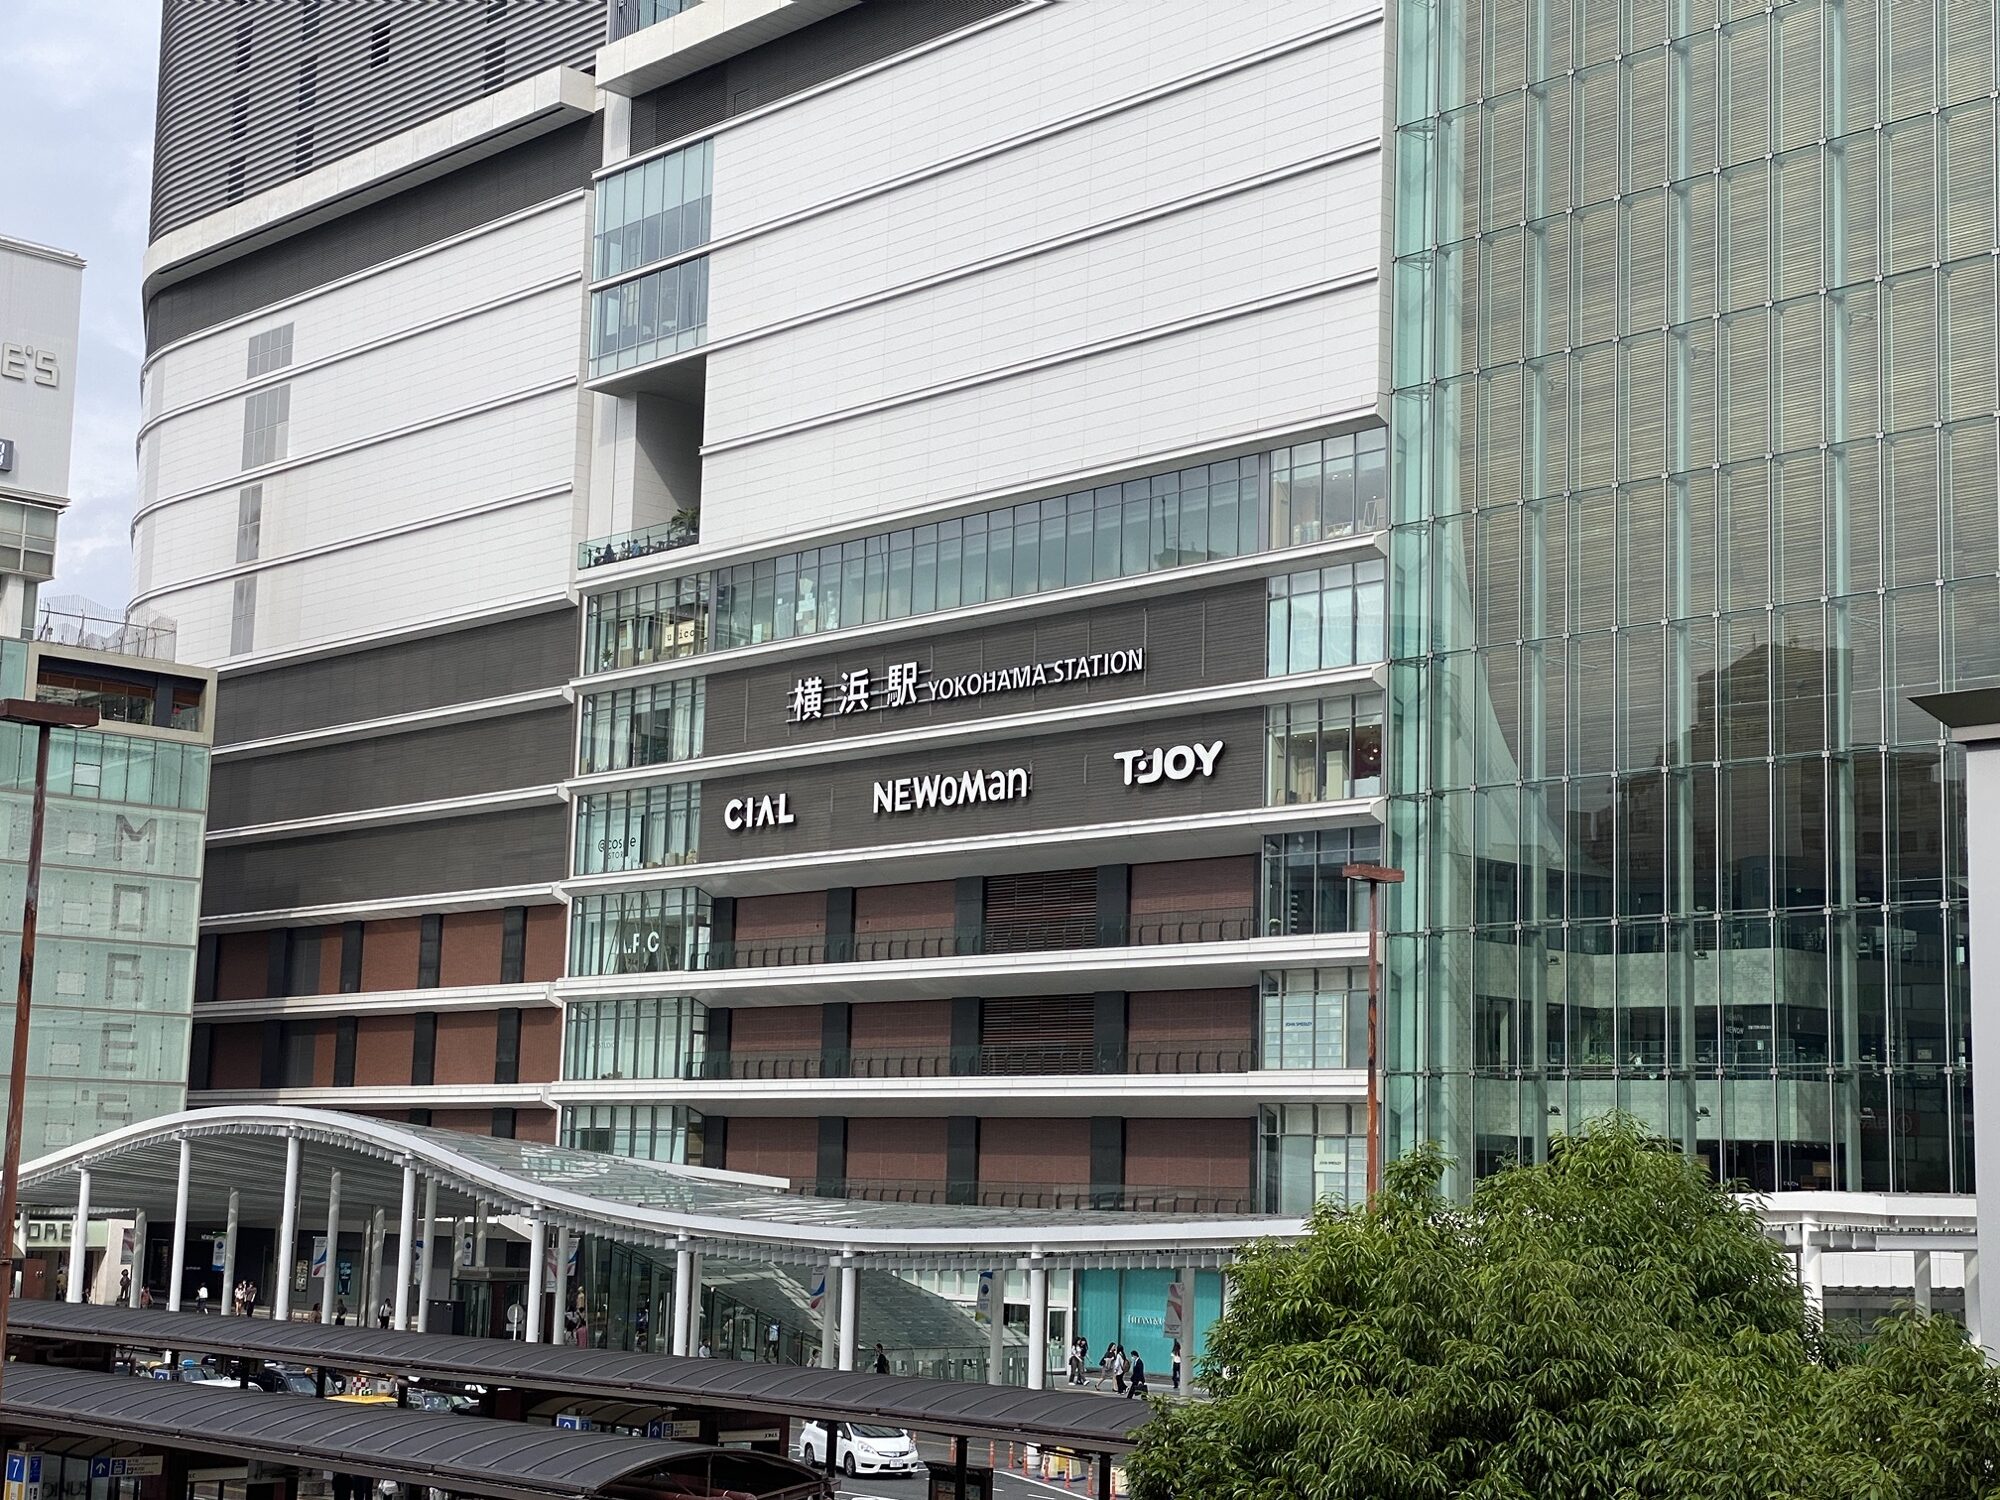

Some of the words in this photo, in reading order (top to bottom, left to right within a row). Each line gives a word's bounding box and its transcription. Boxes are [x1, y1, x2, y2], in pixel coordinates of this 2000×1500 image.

[667, 629, 695, 641] uico
[928, 664, 1047, 701] YOKOHAMA
[1054, 648, 1143, 683] STATION
[794, 661, 917, 721] 横浜駅
[873, 767, 1028, 814] NEWoMan
[724, 793, 795, 830] CIAL
[598, 837, 636, 852] @cose
[608, 851, 623, 859] STOR
[28, 1223, 72, 1240] ORE
[13, 1458, 20, 1478] 7
